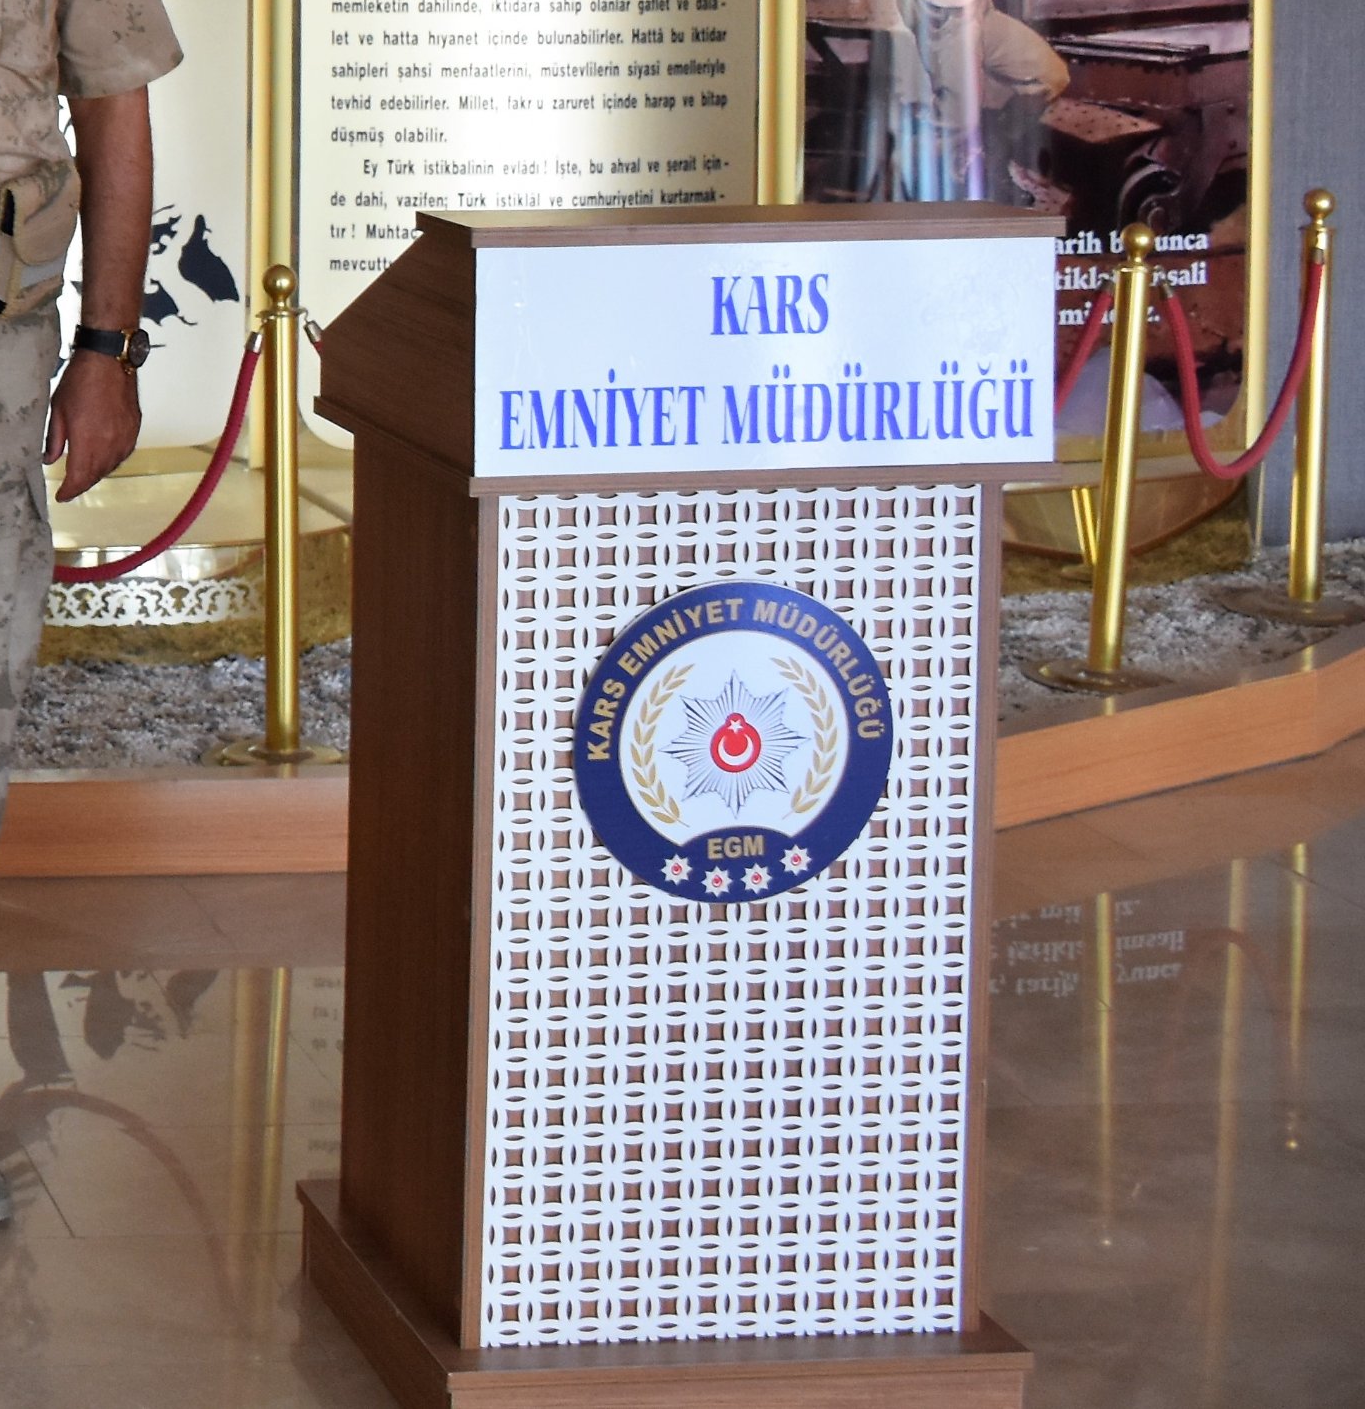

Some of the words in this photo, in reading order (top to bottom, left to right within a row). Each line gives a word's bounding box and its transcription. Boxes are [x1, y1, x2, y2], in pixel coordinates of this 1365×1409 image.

[331, 29, 349, 45] let
[383, 30, 418, 45] hatta
[331, 61, 388, 81] sahipleri
[627, 60, 660, 79] siyasi
[330, 94, 371, 110] tevhid
[552, 95, 594, 110] zaruret
[394, 127, 447, 142] olabilir.
[363, 158, 378, 177] Ey
[423, 159, 494, 175] istikbalinin
[1056, 230, 1102, 255] arih
[710, 272, 830, 336] KARS
[499, 367, 705, 451] EMNİYET
[721, 357, 1035, 445] MÜDÜRLÜĞÜ
[587, 678, 627, 761] KARS
[617, 598, 743, 677] EMNİYET
[752, 598, 887, 739] MÜDÜRLÜĞÜ
[707, 835, 765, 860] EGM
